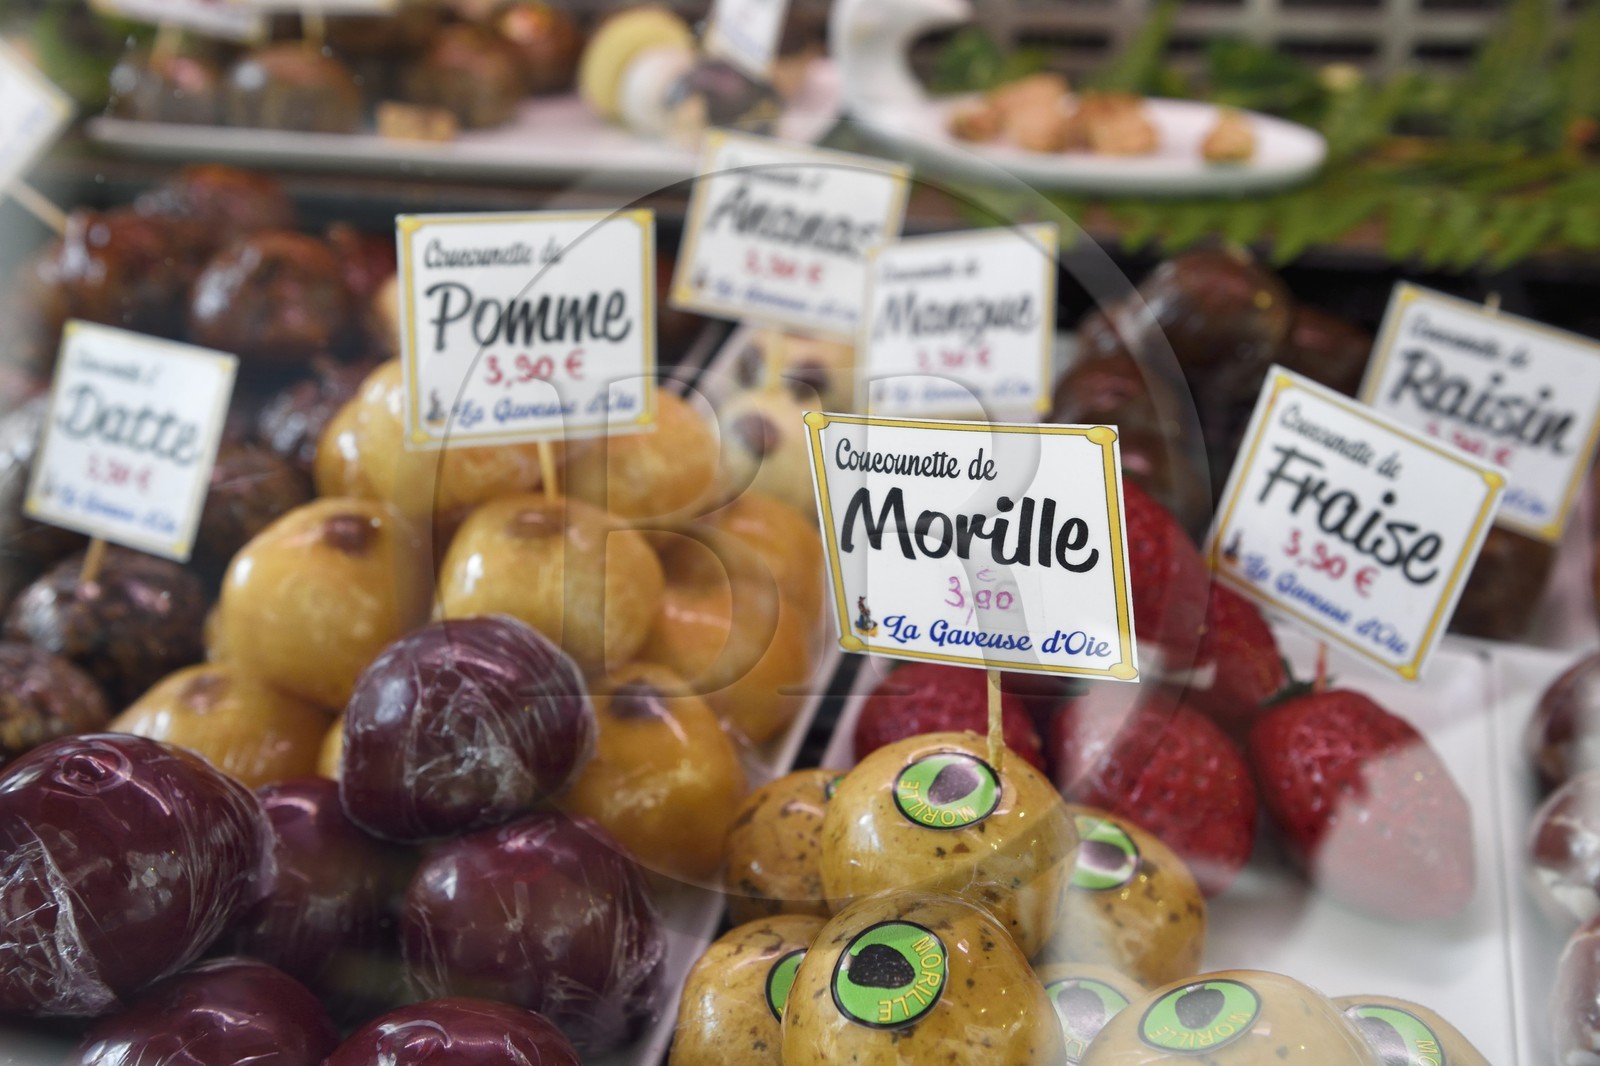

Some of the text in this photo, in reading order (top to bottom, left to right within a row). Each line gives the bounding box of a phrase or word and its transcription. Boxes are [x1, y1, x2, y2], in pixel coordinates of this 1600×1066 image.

[424, 281, 632, 352] Pomme
[485, 348, 586, 388] 3,90 €
[1389, 346, 1576, 456] Raisin
[57, 381, 201, 466] Datte
[835, 438, 998, 481] Coucounette de
[840, 487, 1099, 573] Morille
[1257, 444, 1444, 586] Fraise
[1284, 529, 1379, 597] 3,90 €
[944, 576, 1014, 626] 3,90
[883, 615, 1112, 658] La Gaveuse d'Oie
[900, 779, 977, 826] MORILLE
[877, 934, 942, 1022] MORILLE
[1149, 1011, 1253, 1048] MORILLE
